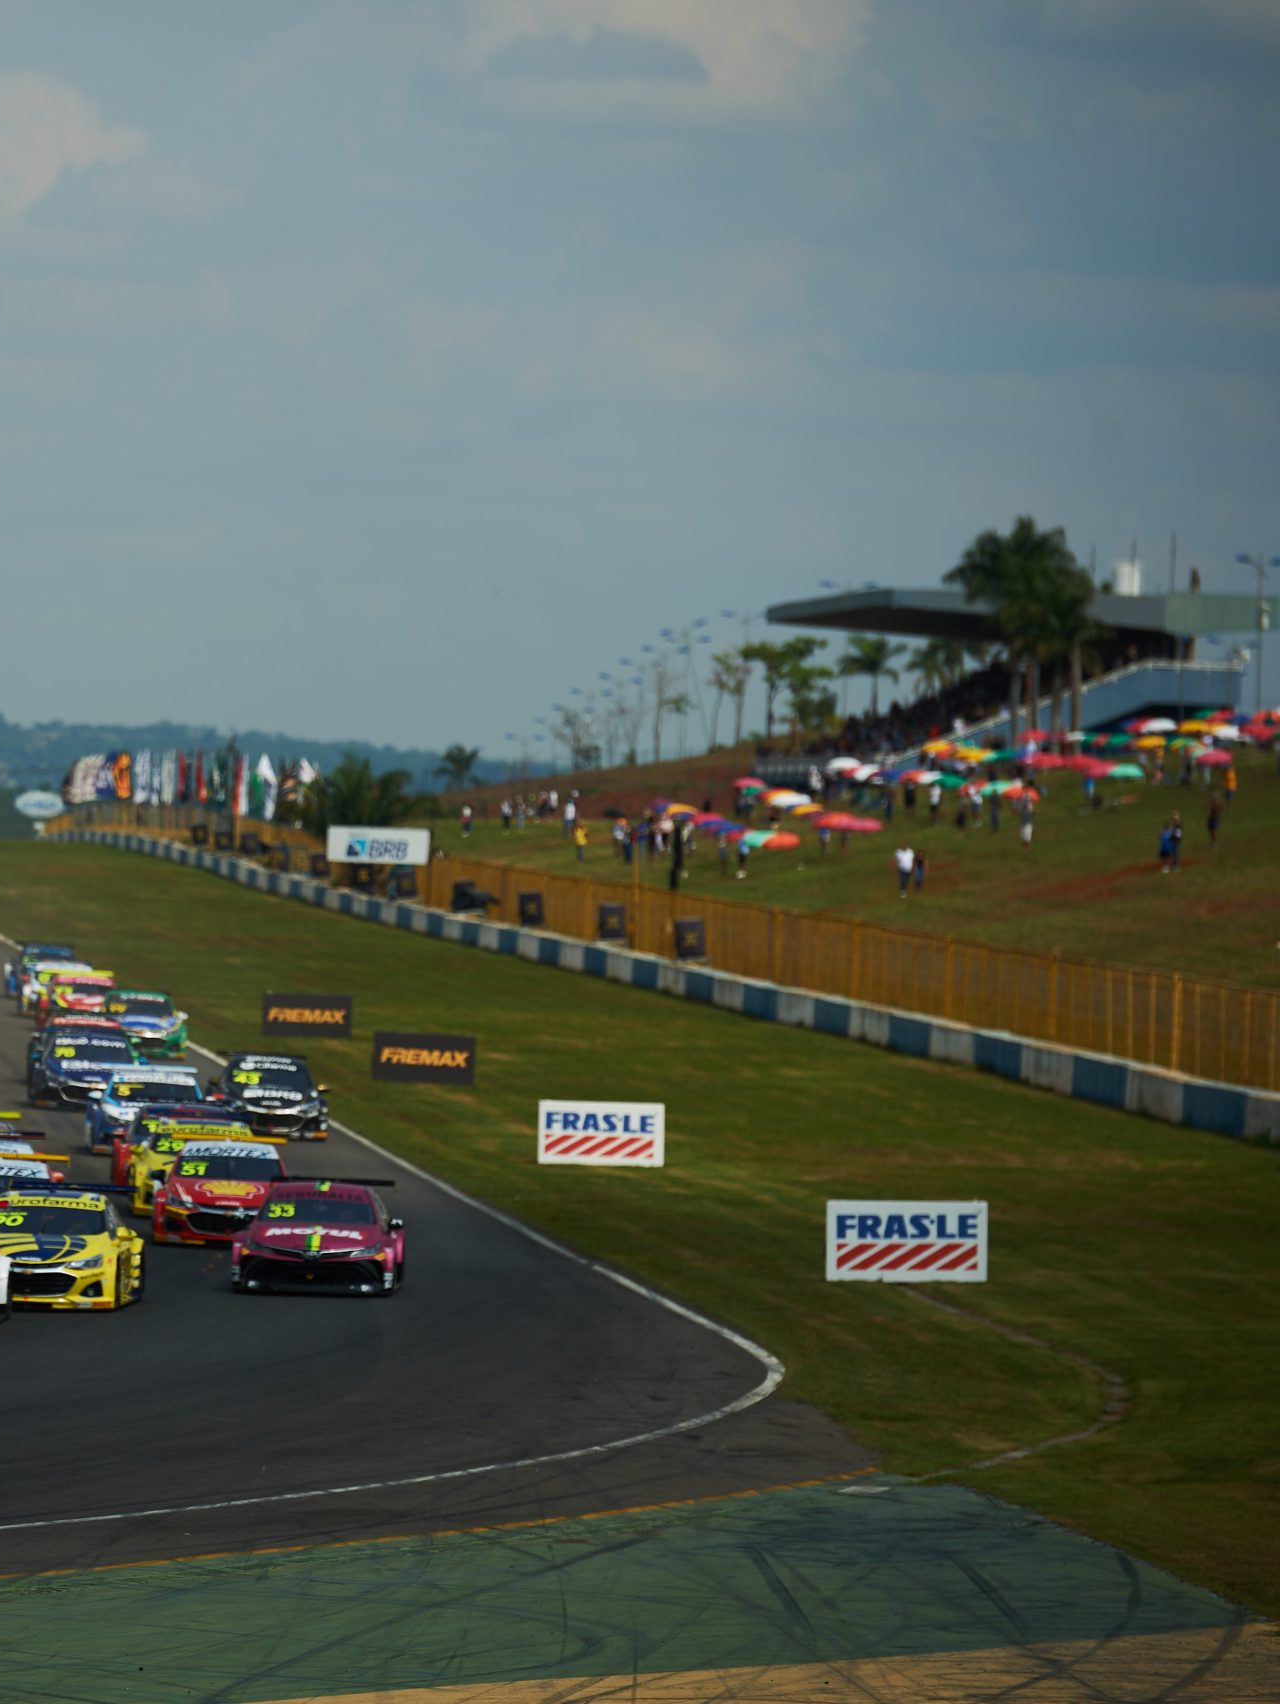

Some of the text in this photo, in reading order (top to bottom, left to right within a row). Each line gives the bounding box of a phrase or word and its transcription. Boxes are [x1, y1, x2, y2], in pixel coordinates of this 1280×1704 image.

[370, 839, 408, 859] BRB
[267, 1007, 346, 1024] FREMAX
[380, 1047, 469, 1068] FREMAX
[179, 1163, 208, 1176] 51
[267, 1203, 296, 1218] 33
[265, 1227, 363, 1240] MOTUL
